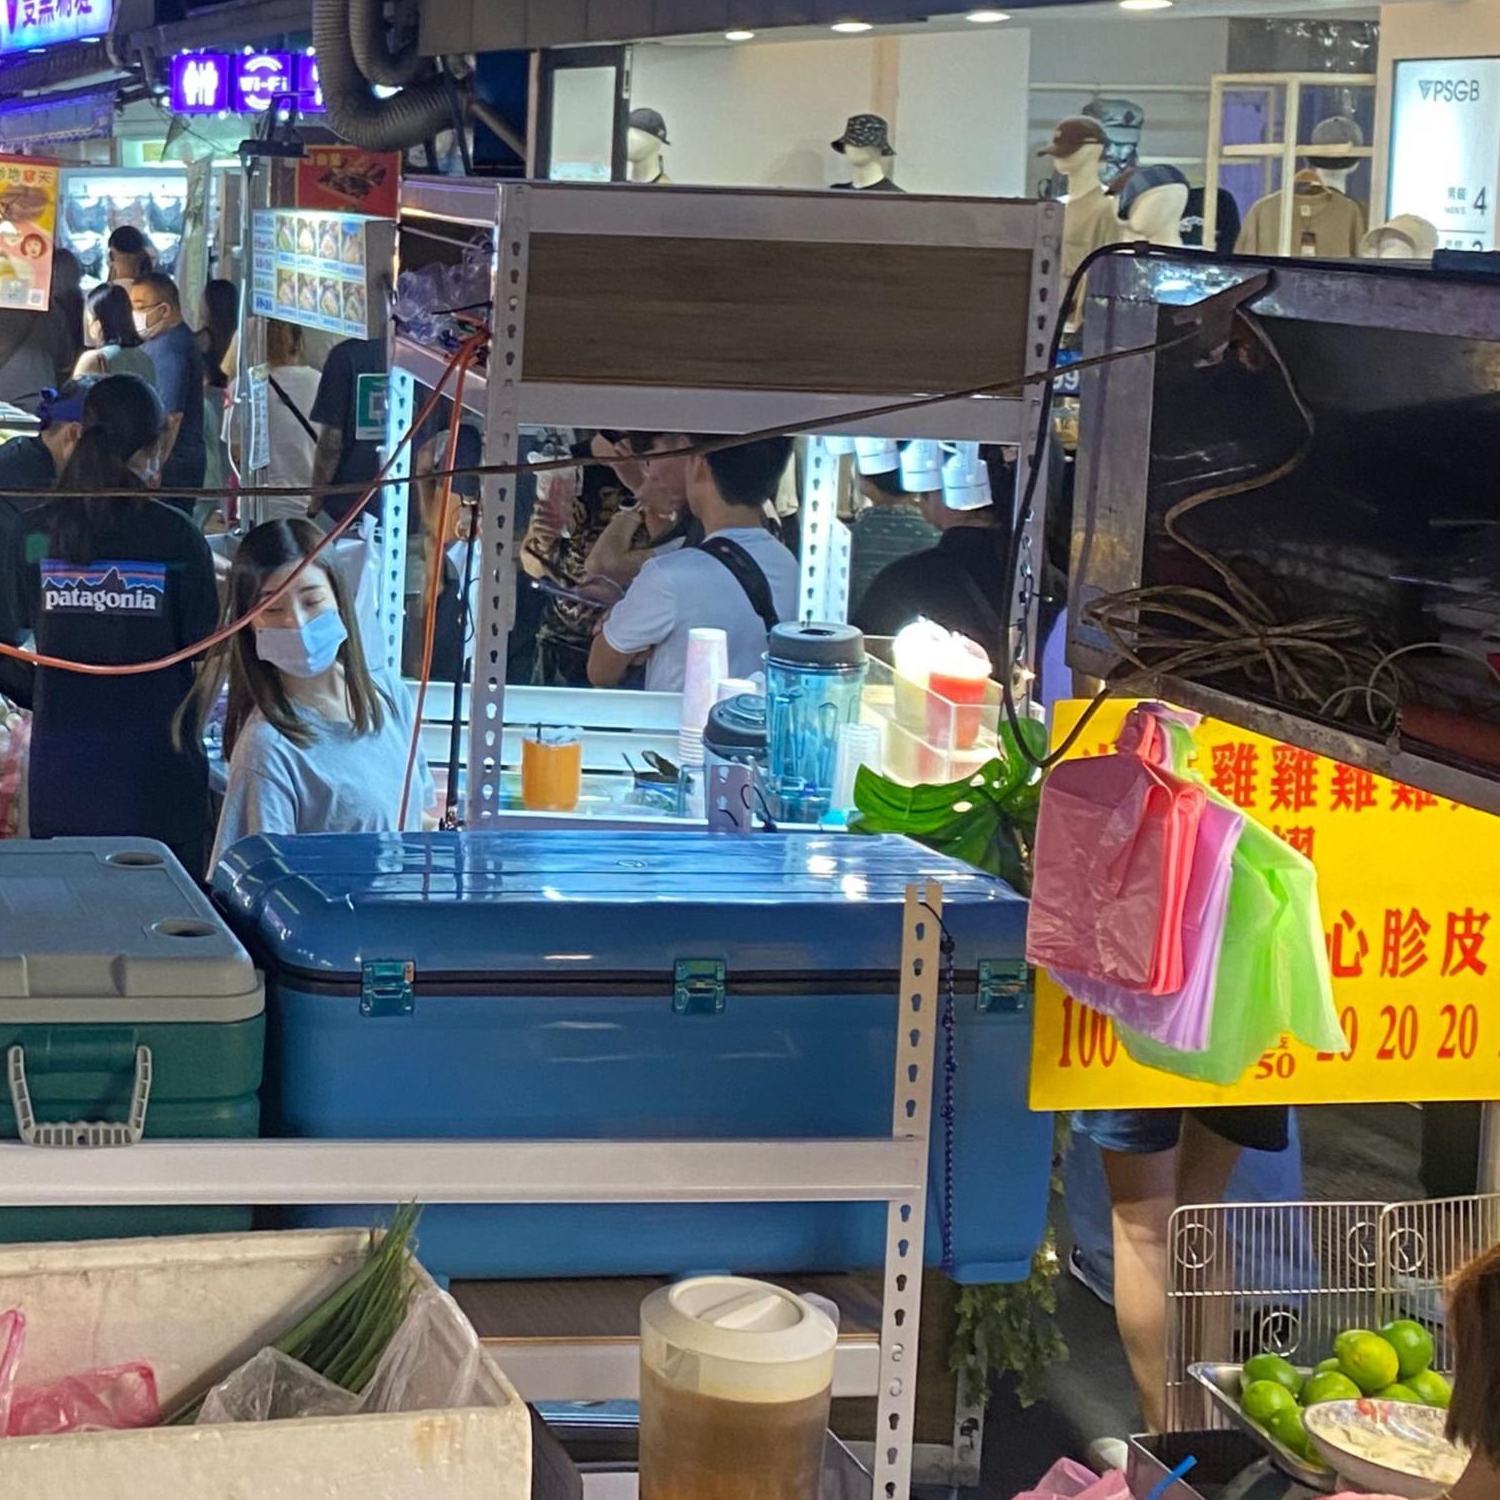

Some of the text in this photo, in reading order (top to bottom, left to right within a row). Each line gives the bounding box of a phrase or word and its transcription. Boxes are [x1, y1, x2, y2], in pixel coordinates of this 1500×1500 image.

[239, 75, 288, 92] Wi-Fi
[1473, 185, 1488, 216] 4
[45, 587, 156, 611] patagonia
[1375, 1004, 1419, 1061] 20
[1436, 1003, 1479, 1061] 20
[1254, 1051, 1297, 1080] 50
